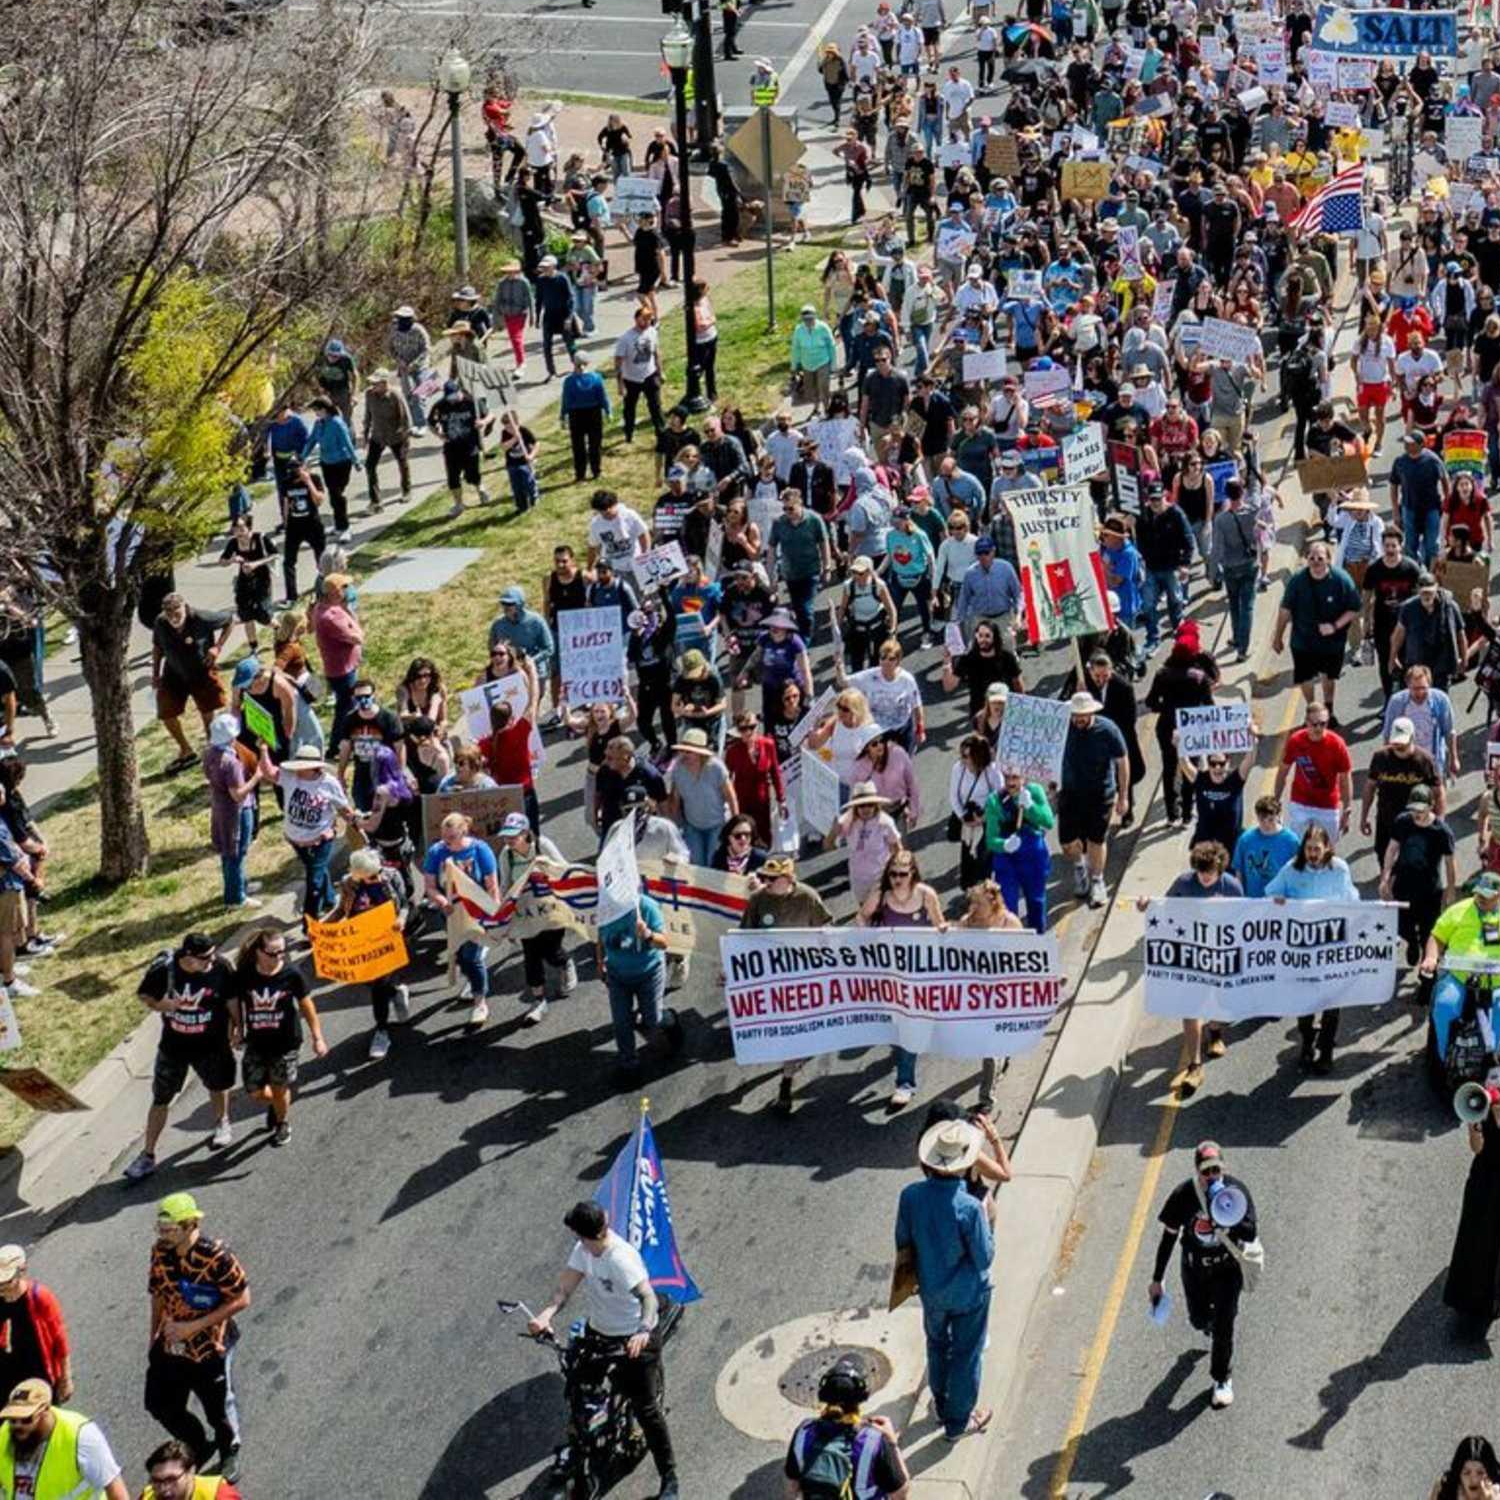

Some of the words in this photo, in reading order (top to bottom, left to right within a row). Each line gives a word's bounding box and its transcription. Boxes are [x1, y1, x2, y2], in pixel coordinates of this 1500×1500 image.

[1361, 14, 1453, 45] SALT
[1007, 488, 1081, 508] THIRSTY
[1020, 515, 1081, 539] JUSTICE
[1179, 707, 1220, 727] Donald
[1193, 920, 1208, 945] IT
[1216, 924, 1235, 947] IS
[1242, 920, 1282, 943] OUR
[1288, 920, 1344, 947] DUTY
[731, 949, 765, 982] NO
[768, 946, 838, 975] KINGS
[839, 945, 857, 967] &
[859, 942, 892, 969] NO
[894, 943, 1050, 975] BILLIONAIRES!
[1149, 942, 1176, 965] TO
[1180, 944, 1241, 976] FIGHT
[1246, 950, 1276, 969] FOR
[1281, 949, 1311, 969] OUR
[1316, 944, 1393, 966] FREEDOM!
[730, 988, 768, 1019] WE
[770, 982, 824, 1014] NEED
[829, 978, 844, 1005] A
[845, 977, 911, 1009] WHOLE
[912, 983, 963, 1013] NEW
[967, 980, 1061, 1011] SYSTEM!
[735, 1026, 763, 1041] PARTY
[763, 1025, 778, 1037] FOR
[779, 1021, 826, 1037] SOCIALISM
[826, 1016, 845, 1029] AND
[845, 1012, 893, 1026] LIBERATION
